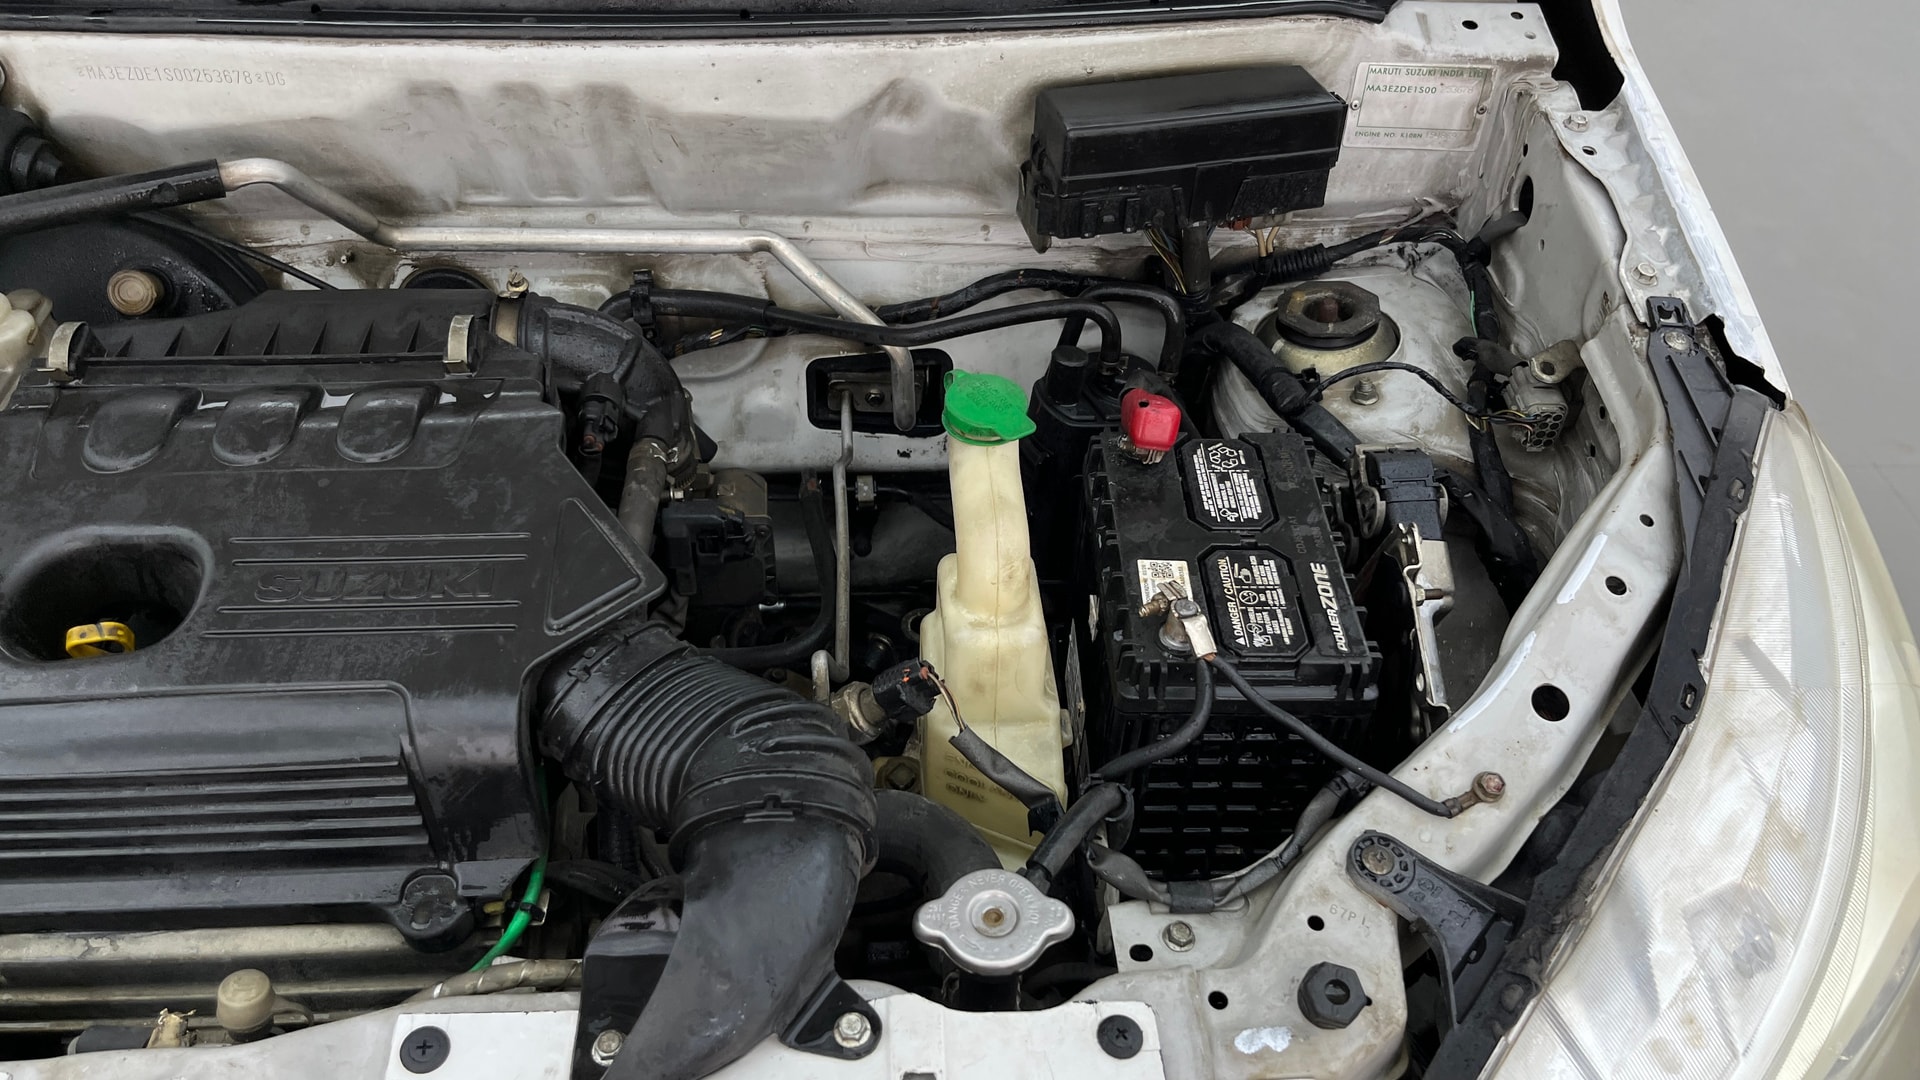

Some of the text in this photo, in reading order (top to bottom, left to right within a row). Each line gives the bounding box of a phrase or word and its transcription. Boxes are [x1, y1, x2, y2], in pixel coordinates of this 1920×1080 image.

[1366, 84, 1437, 95] MA3EZDE1S00
[1369, 67, 1401, 76] MARUTI
[1405, 69, 1437, 77] SUZUKI
[1440, 70, 1465, 78] INDIA
[254, 567, 496, 602] SUZUKI
[1217, 558, 1235, 595] CAUTION
[1226, 600, 1245, 637] DANGER
[1310, 562, 1348, 652] POWERZONE
[968, 873, 1006, 888] NEVER
[1008, 878, 1035, 902] OPEN
